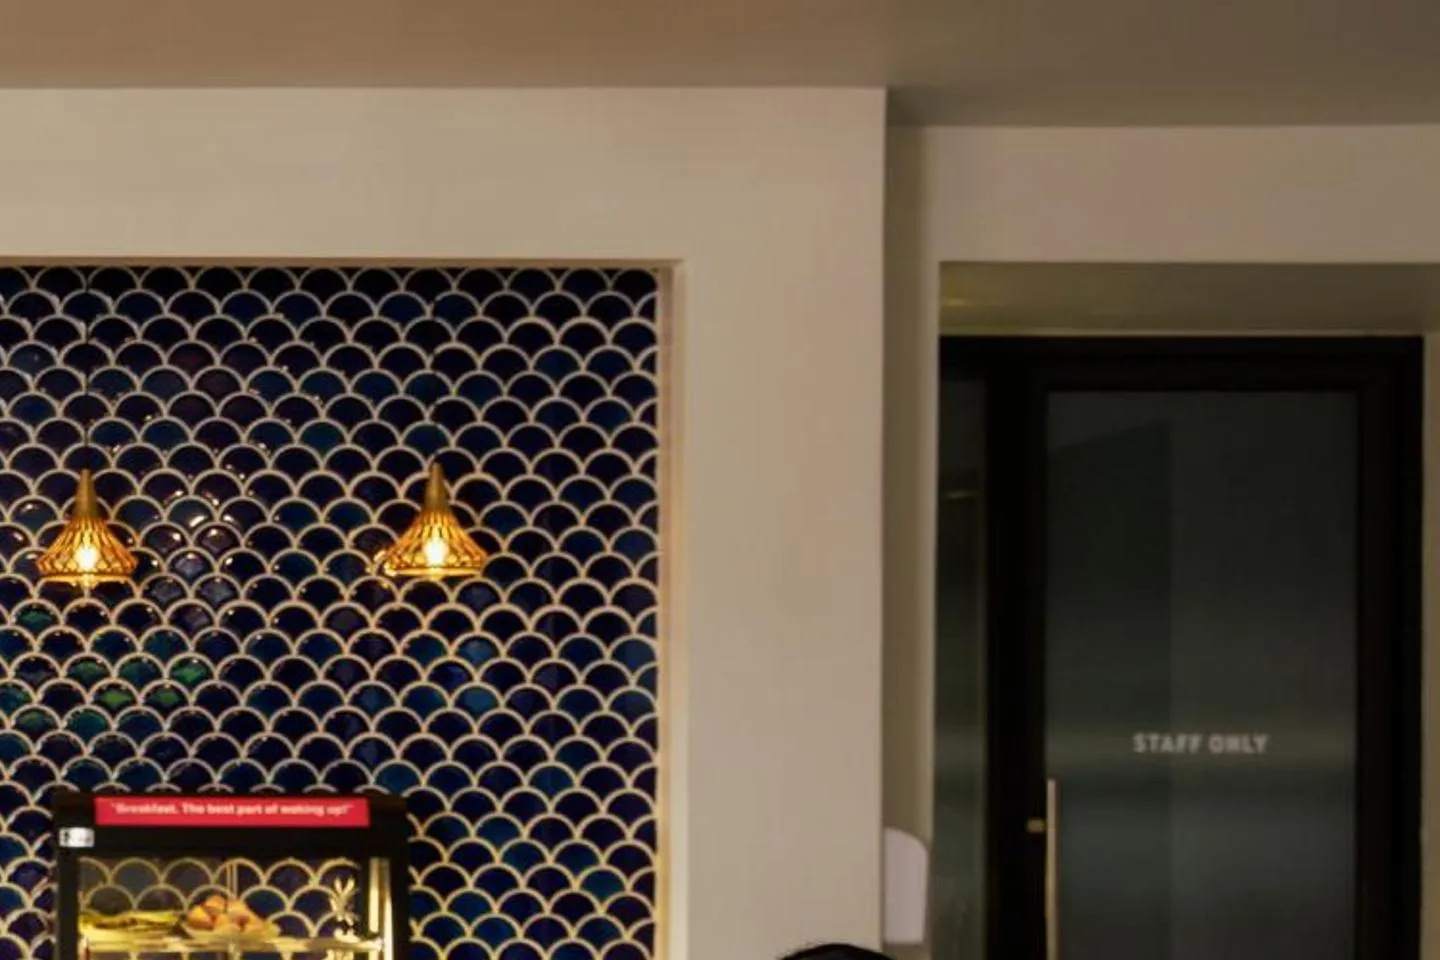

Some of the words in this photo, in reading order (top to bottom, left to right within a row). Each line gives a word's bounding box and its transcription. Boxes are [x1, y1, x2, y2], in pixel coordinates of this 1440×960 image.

[1133, 732, 1202, 753] STAFF
[1209, 732, 1268, 753] ONLY
[182, 802, 205, 815] The
[207, 803, 234, 815] best
[235, 804, 262, 818] part
[264, 802, 278, 815] of
